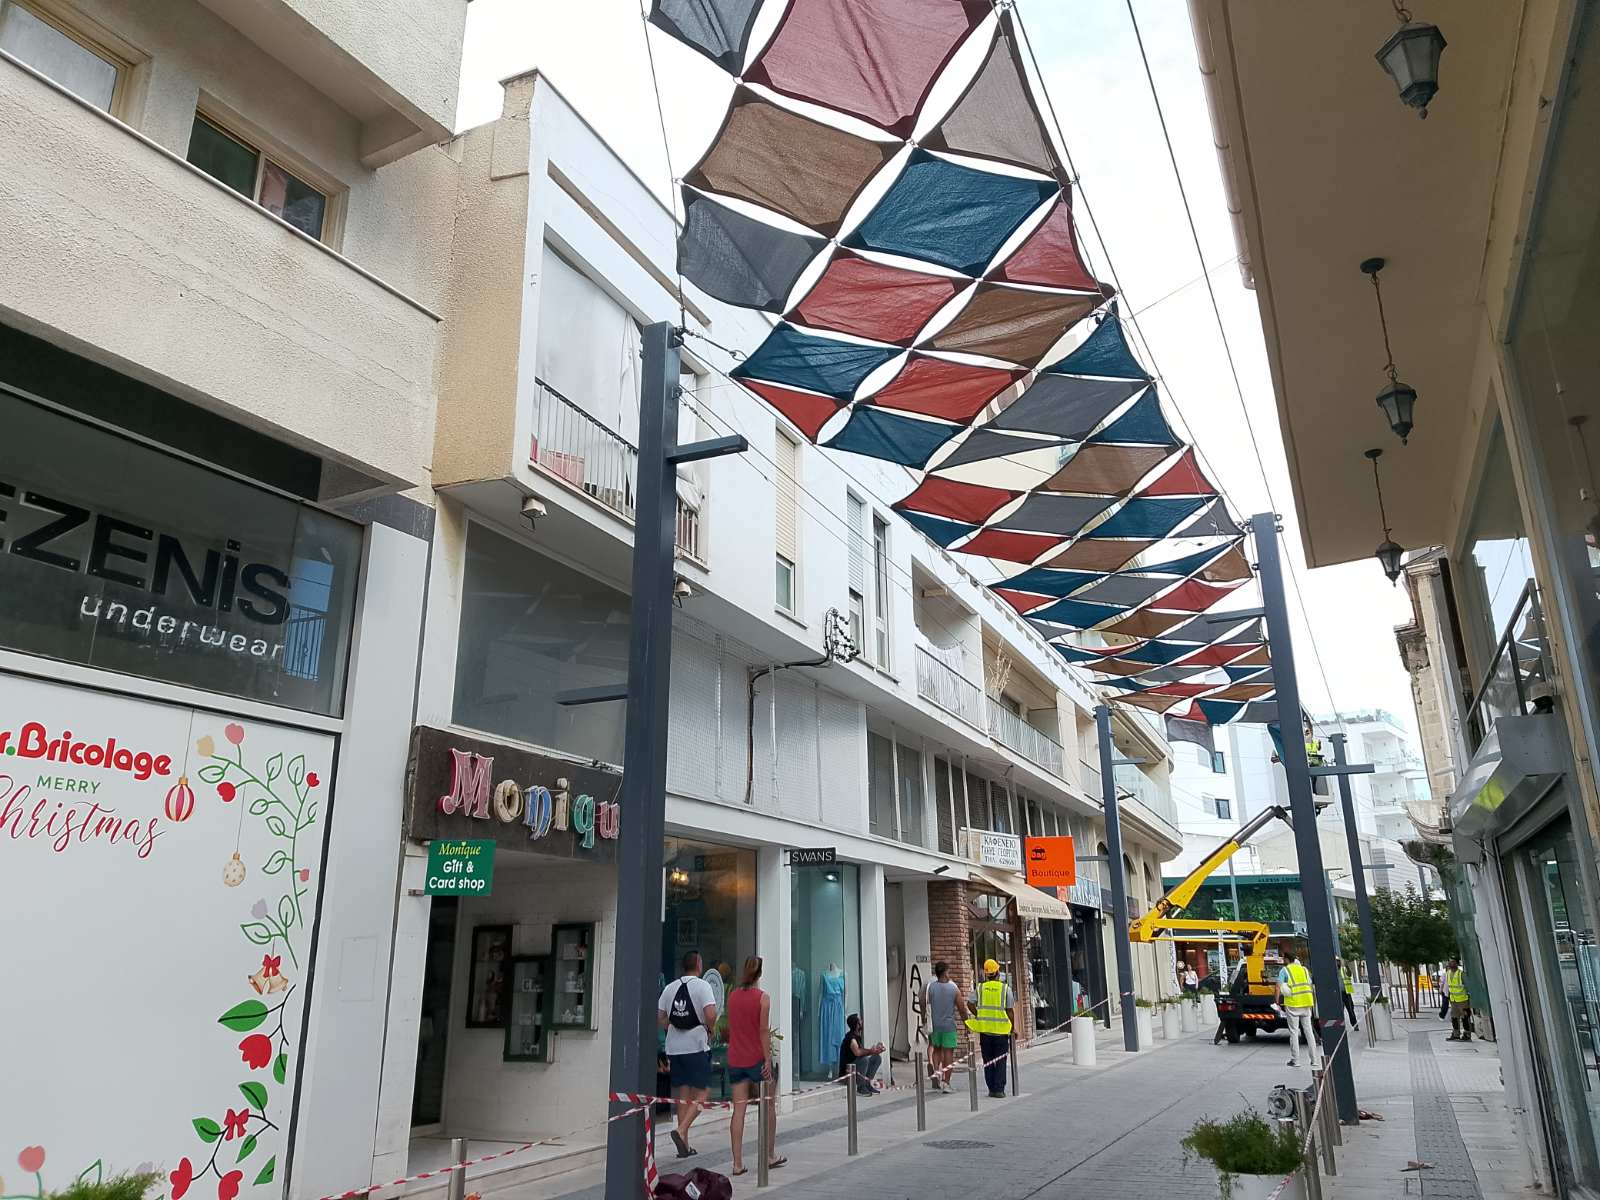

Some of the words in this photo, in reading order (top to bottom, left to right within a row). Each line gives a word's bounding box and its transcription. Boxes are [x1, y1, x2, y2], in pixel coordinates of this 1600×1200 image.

[79, 594, 285, 661] underwear
[36, 775, 102, 795] MERRY
[438, 841, 482, 859] Monique
[792, 850, 833, 863] SWANS
[443, 859, 463, 873] Gift
[466, 860, 474, 873] &
[1031, 868, 1071, 878] Boutique
[429, 876, 456, 889] Card
[458, 876, 485, 891] shop
